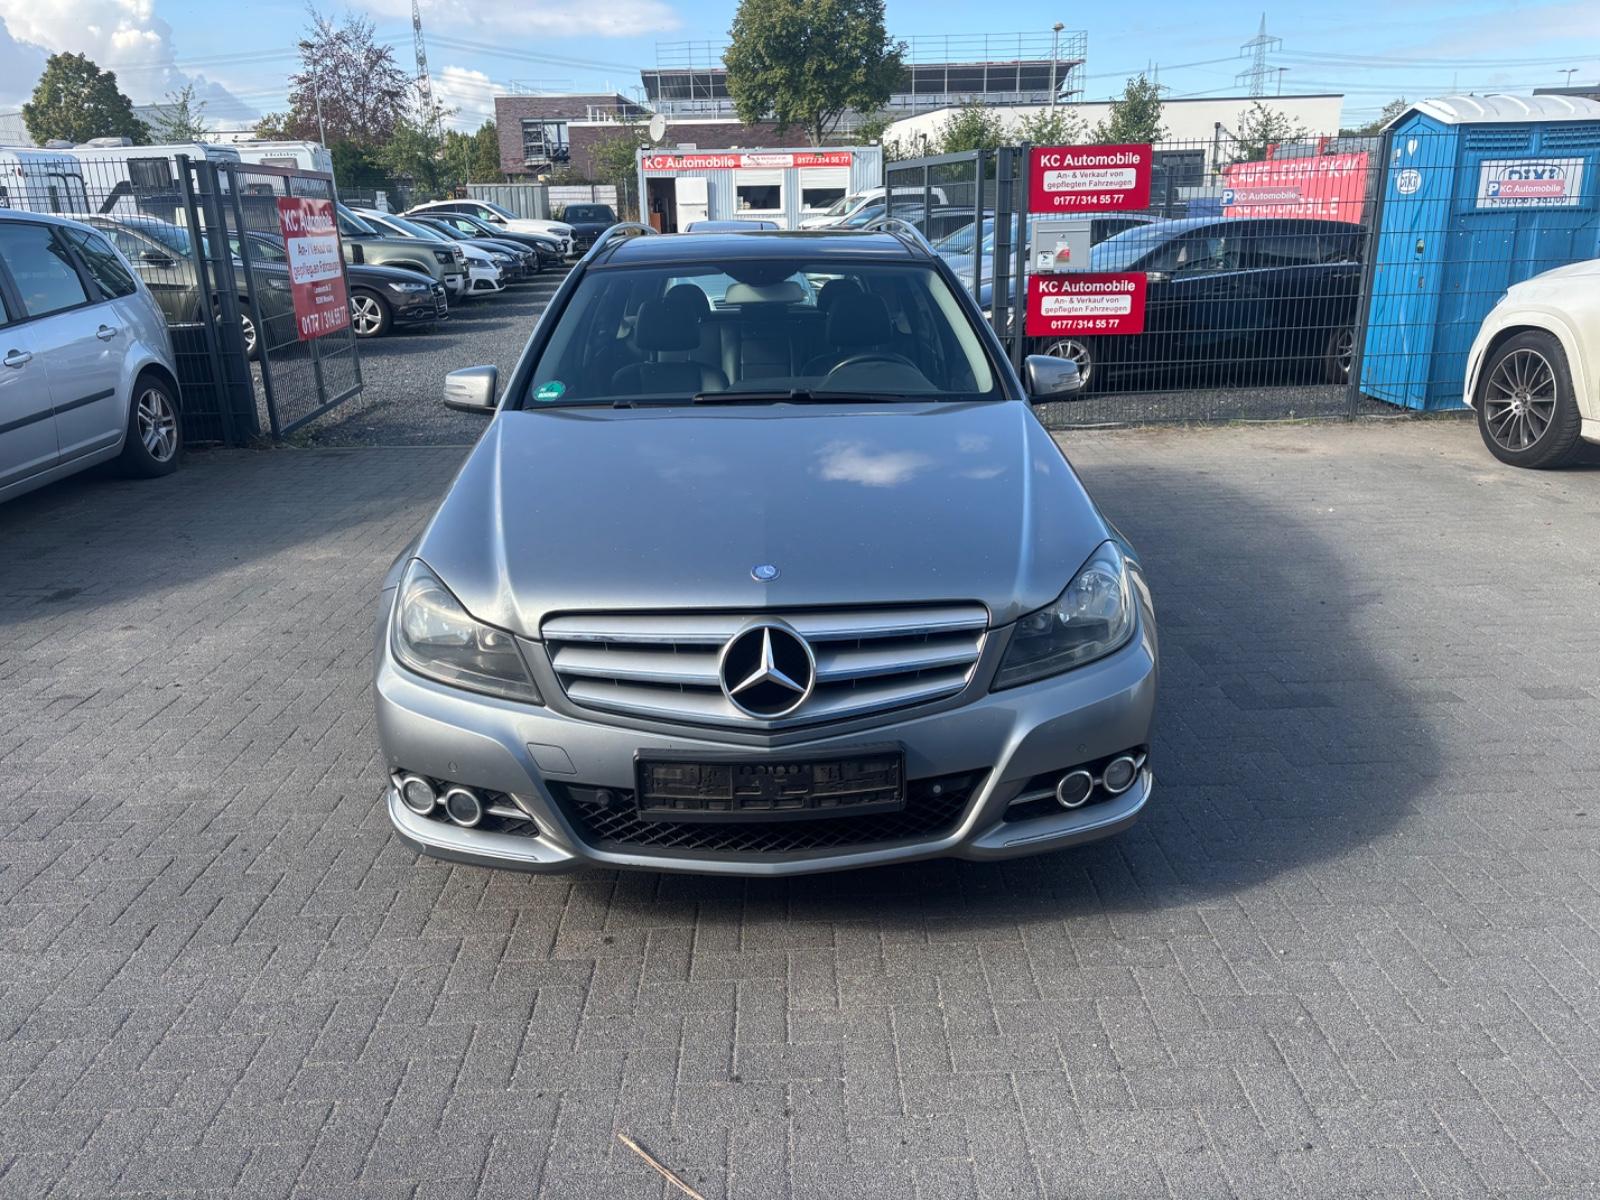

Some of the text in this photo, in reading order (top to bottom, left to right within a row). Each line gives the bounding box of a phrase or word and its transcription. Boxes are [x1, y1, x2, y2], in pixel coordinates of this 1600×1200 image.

[645, 155, 735, 169] KC Automobile
[1040, 152, 1140, 167] KC Automobile
[1319, 158, 1358, 178] PKW
[1072, 171, 1077, 179] &
[1080, 171, 1107, 179] Verkauf
[1047, 179, 1132, 190] gepflegten Fahrzeugen
[1500, 185, 1513, 193] KC
[1514, 184, 1561, 193] Automobile
[1100, 194, 1111, 204] 55
[1113, 194, 1124, 203] 77
[1234, 192, 1247, 201] KC
[1249, 191, 1296, 200] Automobile
[284, 209, 298, 231] KC
[1039, 280, 1136, 293] KC Automobile
[1045, 305, 1128, 314] gepflegten Fahrzeugen
[1096, 319, 1106, 328] 55
[1108, 319, 1119, 328] 77
